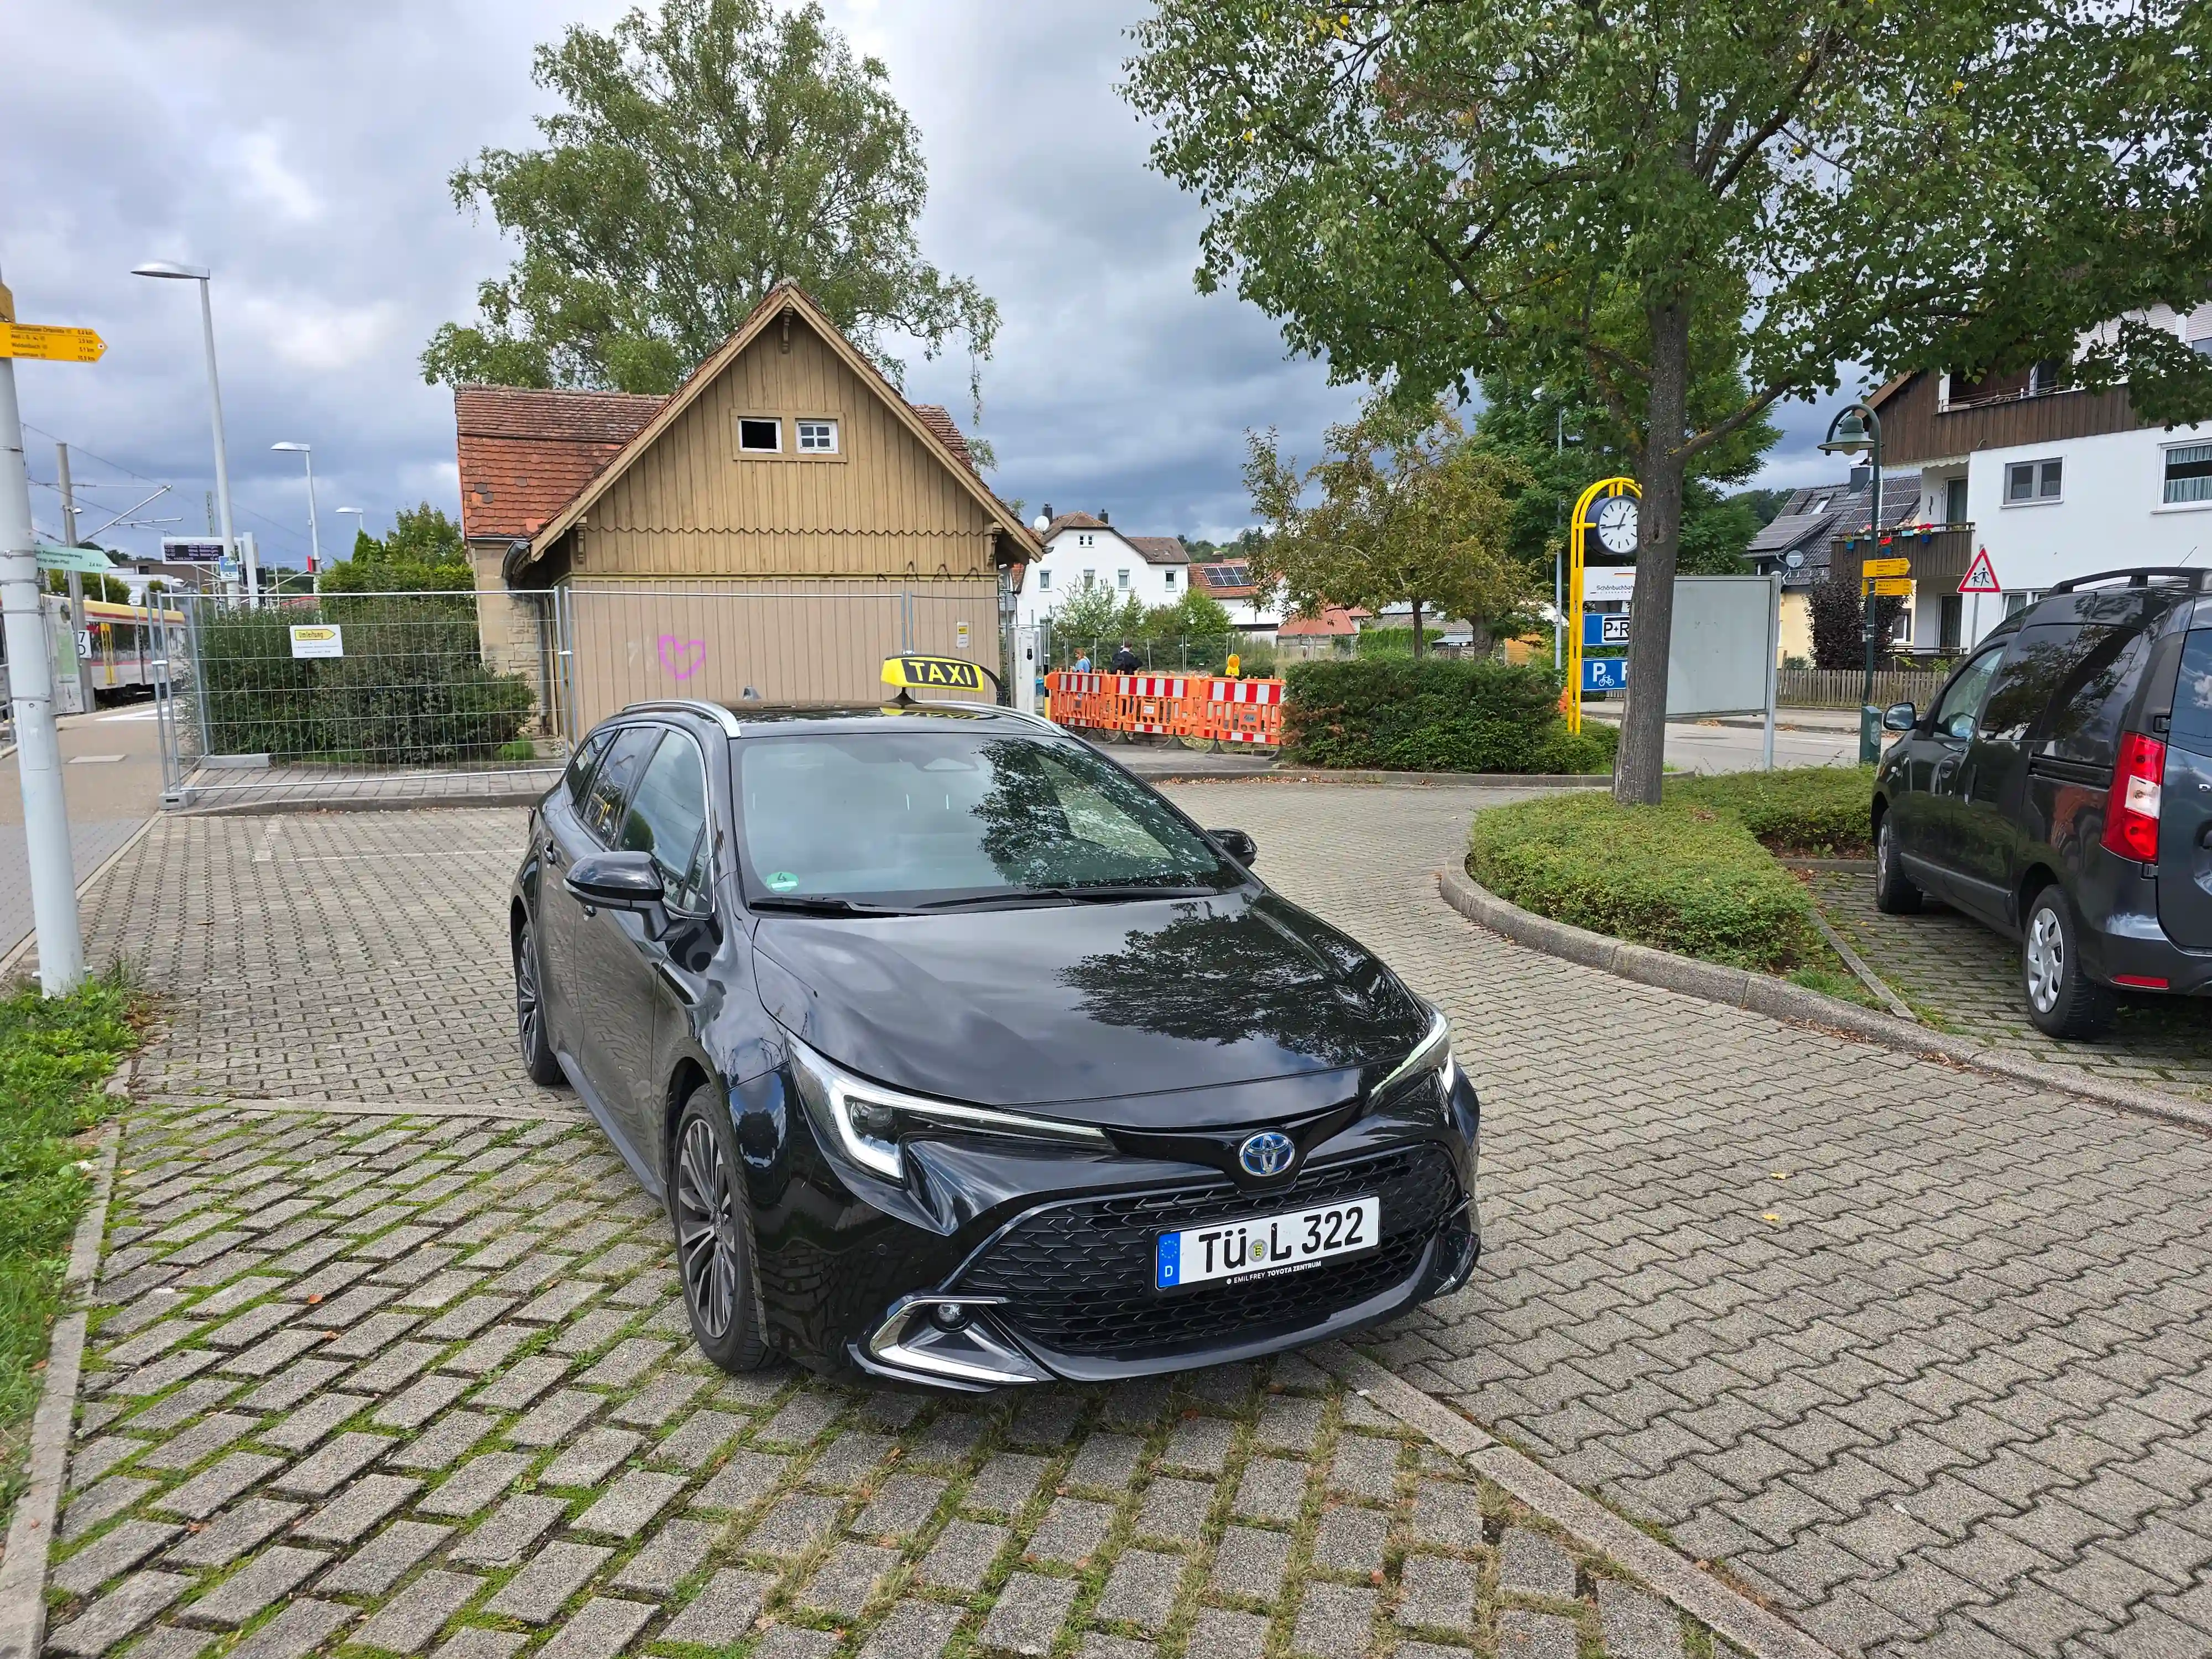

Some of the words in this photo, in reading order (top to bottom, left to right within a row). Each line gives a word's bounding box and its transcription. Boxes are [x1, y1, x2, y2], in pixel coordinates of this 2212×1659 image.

[1604, 622, 1629, 637] P+R
[908, 661, 972, 685] TAXI
[1593, 662, 1606, 682] P
[1198, 1228, 1246, 1273] TÜ
[1270, 1222, 1292, 1261] L
[1302, 1207, 1363, 1254] 322
[1165, 1265, 1173, 1277] D
[1234, 1275, 1249, 1284] EMIL
[1250, 1272, 1265, 1281] FREY
[1267, 1267, 1292, 1276] TOYOTA
[1293, 1261, 1321, 1272] ZENTRUM
